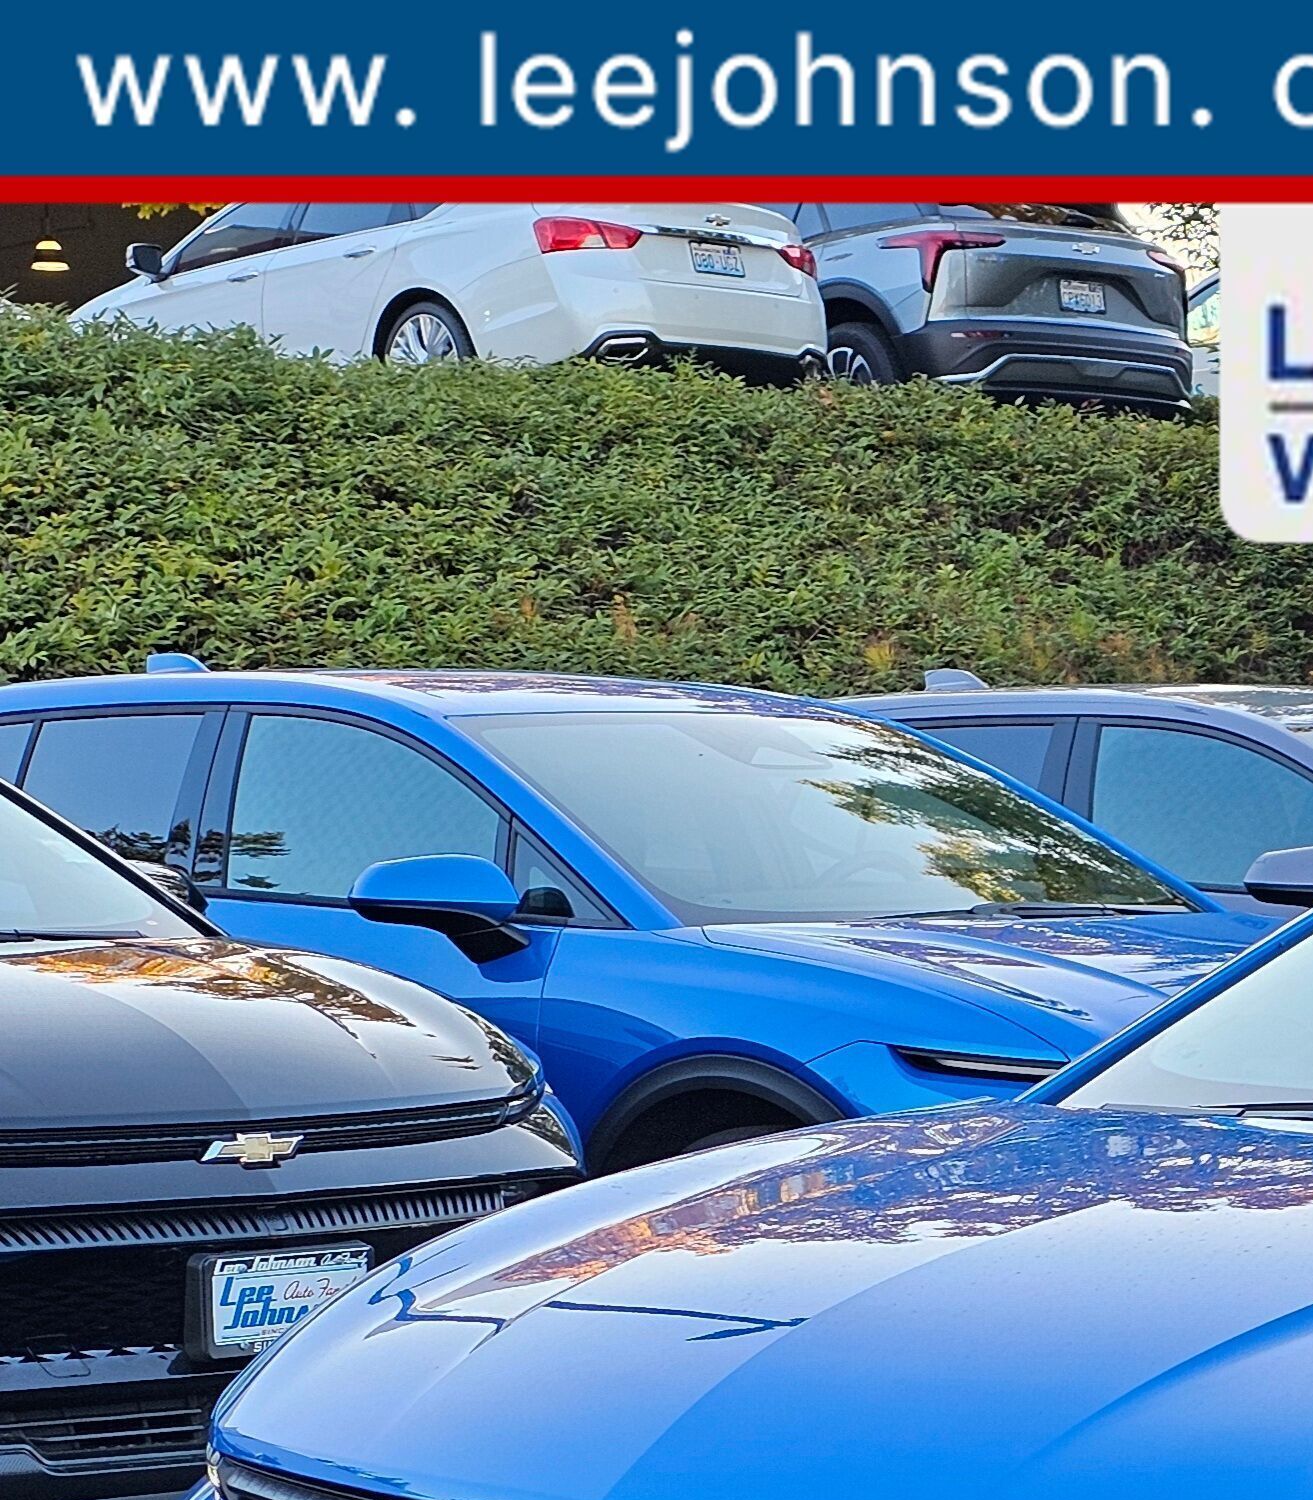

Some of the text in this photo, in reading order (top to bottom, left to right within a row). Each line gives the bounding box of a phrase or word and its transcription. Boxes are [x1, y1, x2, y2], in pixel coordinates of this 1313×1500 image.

[247, 1255, 317, 1273] Johnson
[220, 1277, 277, 1307] Lee
[283, 1280, 315, 1300] Auto
[223, 1297, 309, 1330] John
